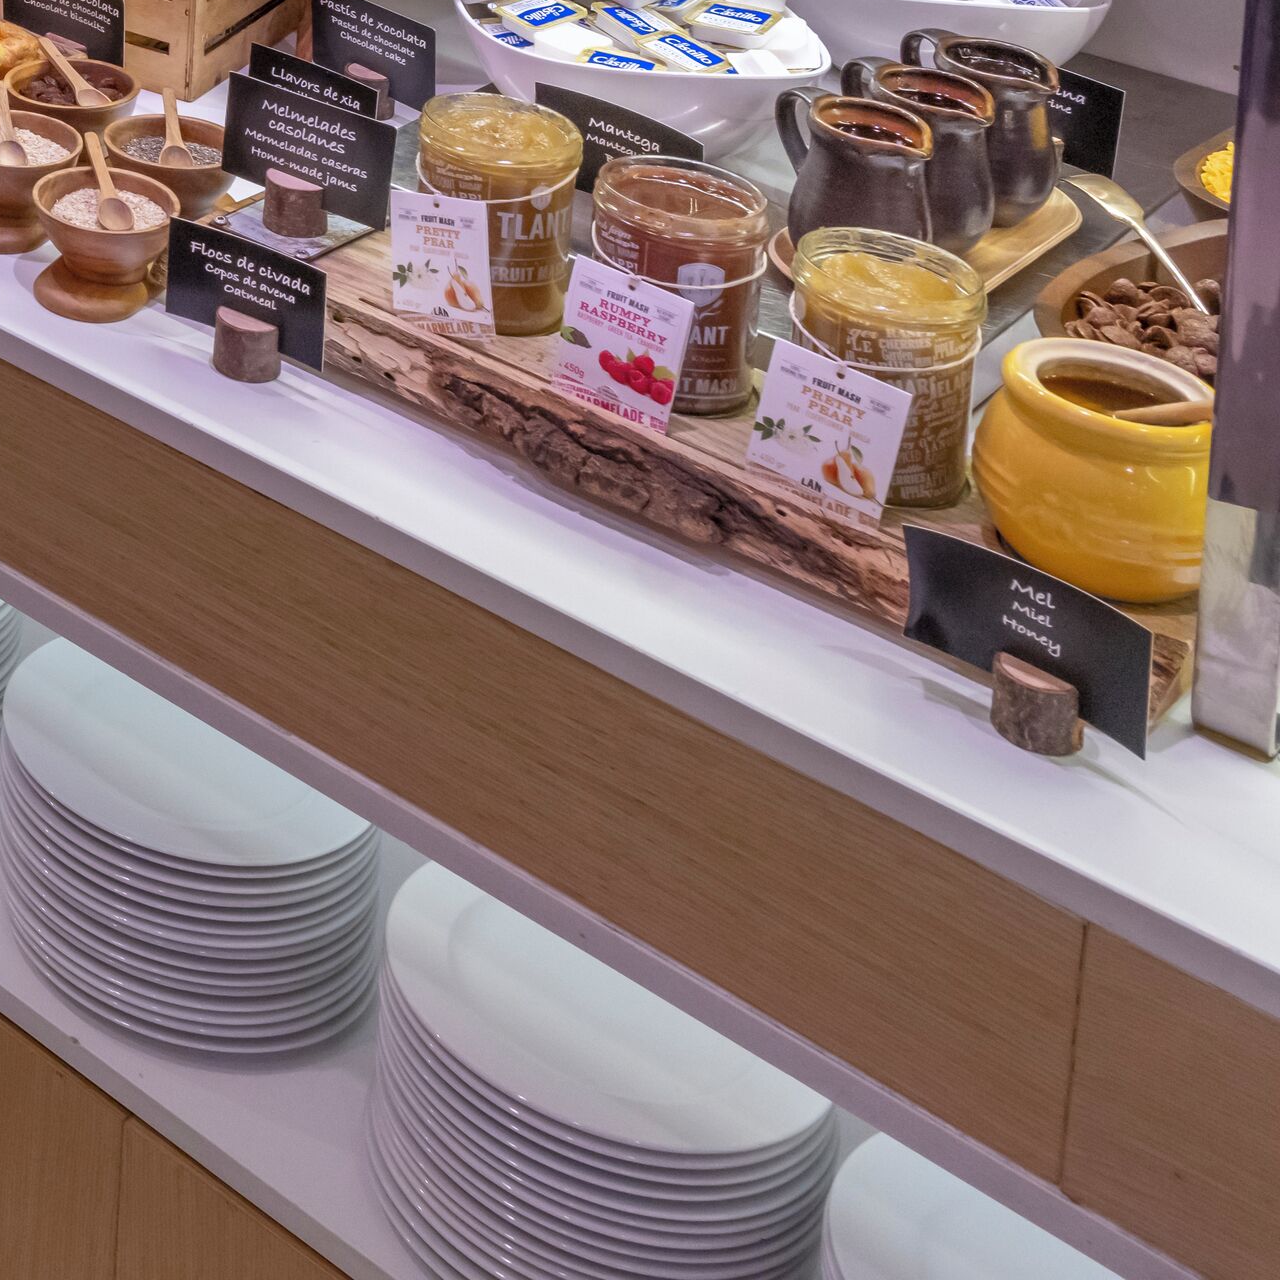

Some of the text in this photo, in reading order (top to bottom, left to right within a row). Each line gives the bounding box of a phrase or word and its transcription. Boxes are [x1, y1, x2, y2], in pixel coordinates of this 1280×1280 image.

[69, 9, 106, 34] biscuits
[72, 1, 112, 26] chocolate
[524, 3, 566, 22] Castillo
[710, 7, 763, 23] Castillo
[330, 15, 416, 59] Pastel de chocolate
[360, 12, 375, 27] de
[375, 20, 428, 50] xocolata
[339, 30, 407, 66] Chocolate cake
[664, 37, 713, 66] Castillo
[271, 66, 321, 94] Llavors
[323, 86, 338, 102] de
[339, 94, 362, 111] xia
[261, 99, 358, 142] Melmelades
[588, 117, 661, 153] Mantega
[268, 119, 346, 155] casolanes
[244, 127, 369, 180] Mermeladas caseras
[251, 145, 358, 193] Home-made jams
[415, 224, 461, 241] PRETTY
[420, 214, 438, 224] FRUIT
[496, 206, 570, 241] TLANT
[423, 235, 456, 250] PEAR
[189, 240, 311, 296] Flocs de civada
[491, 266, 536, 283] FRUIT
[204, 263, 296, 305] Copos de avena
[223, 284, 278, 311] Oatmeal
[598, 297, 652, 328] RUMPY
[605, 289, 650, 314] FRUIT MASH
[579, 300, 669, 346] RASPBERRY
[687, 324, 733, 347] ANT
[562, 360, 586, 380] 450g
[800, 384, 867, 422] PRETTY
[811, 376, 863, 405] FRUIT MASH
[807, 398, 855, 428] PEAR
[1009, 578, 1056, 610] Mel
[1012, 600, 1054, 628] Miel
[1002, 614, 1061, 658] Honey
